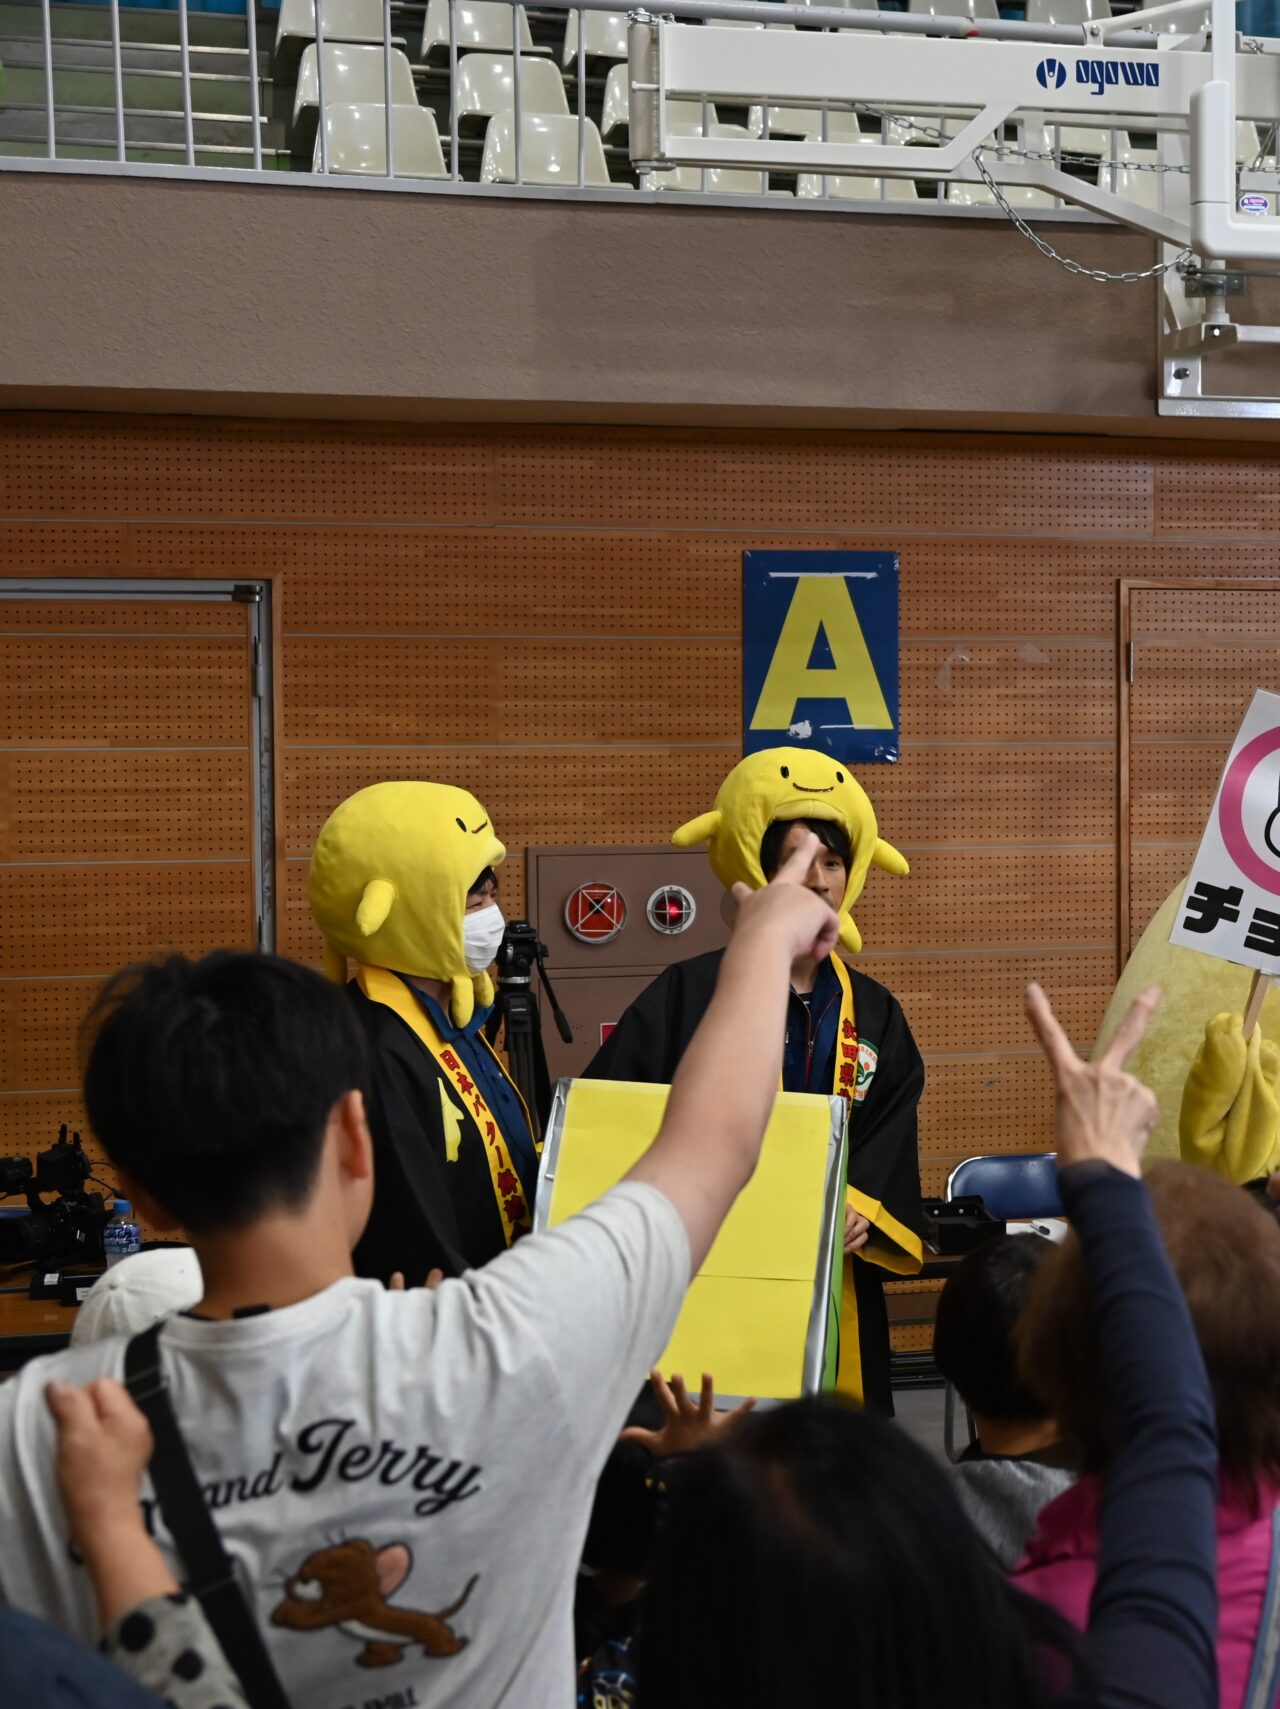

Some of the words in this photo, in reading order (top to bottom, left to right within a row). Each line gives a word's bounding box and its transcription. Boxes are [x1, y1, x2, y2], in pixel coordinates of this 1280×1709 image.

[1076, 60, 1159, 95] ogawa
[749, 575, 894, 730] A
[202, 1453, 284, 1508] and
[290, 1418, 481, 1517] Jerry
